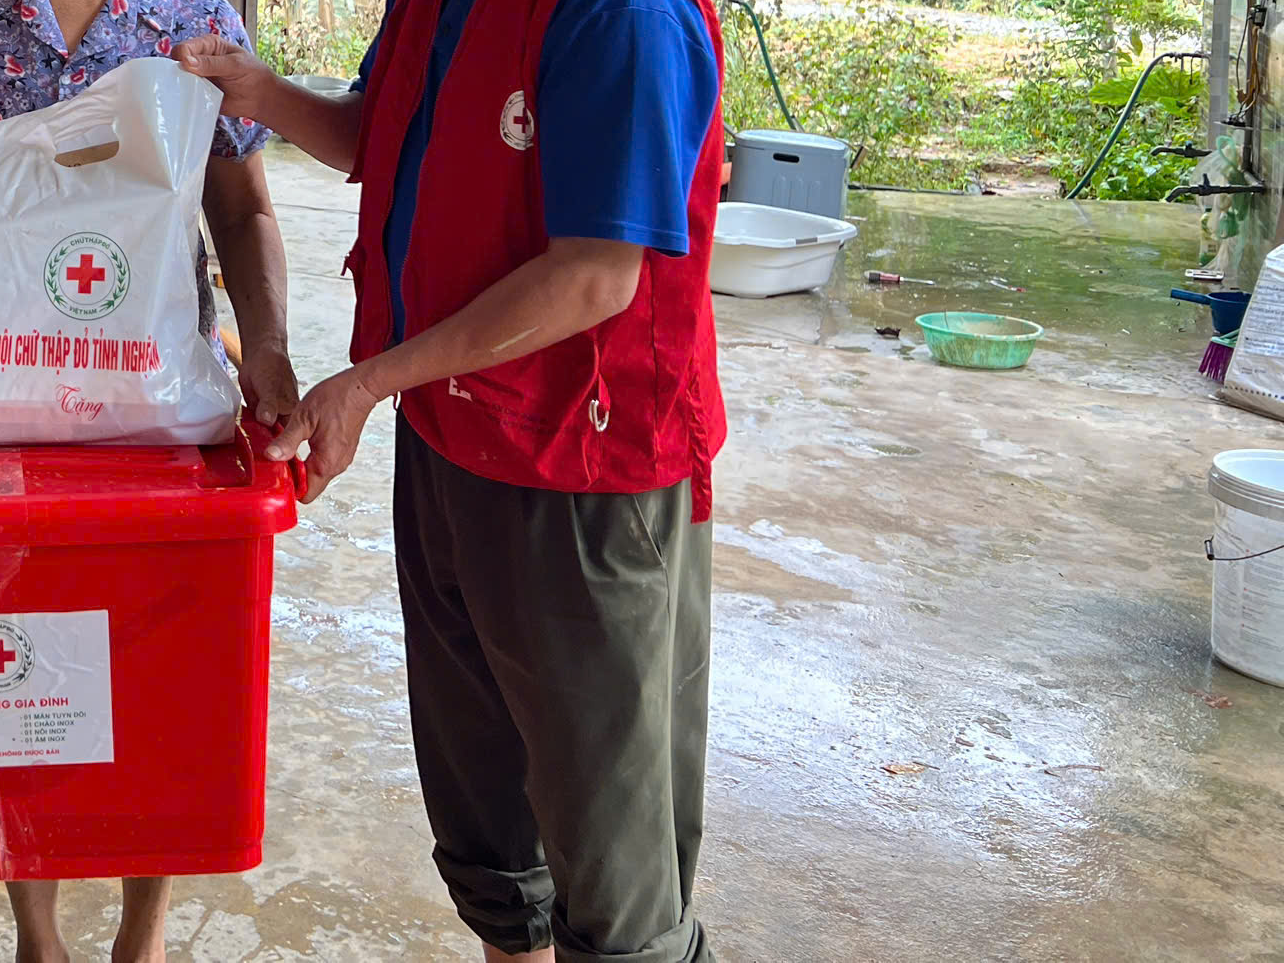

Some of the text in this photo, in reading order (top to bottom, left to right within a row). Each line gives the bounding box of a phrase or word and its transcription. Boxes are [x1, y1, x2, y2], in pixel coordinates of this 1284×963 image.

[15, 328, 40, 366] CHỮ
[42, 329, 70, 375] THẬP
[74, 327, 89, 369] ĐỎ
[93, 328, 118, 371] TỈNH
[55, 384, 104, 422] Tặng
[14, 699, 36, 708] GIA
[40, 696, 68, 707] ĐÌNH
